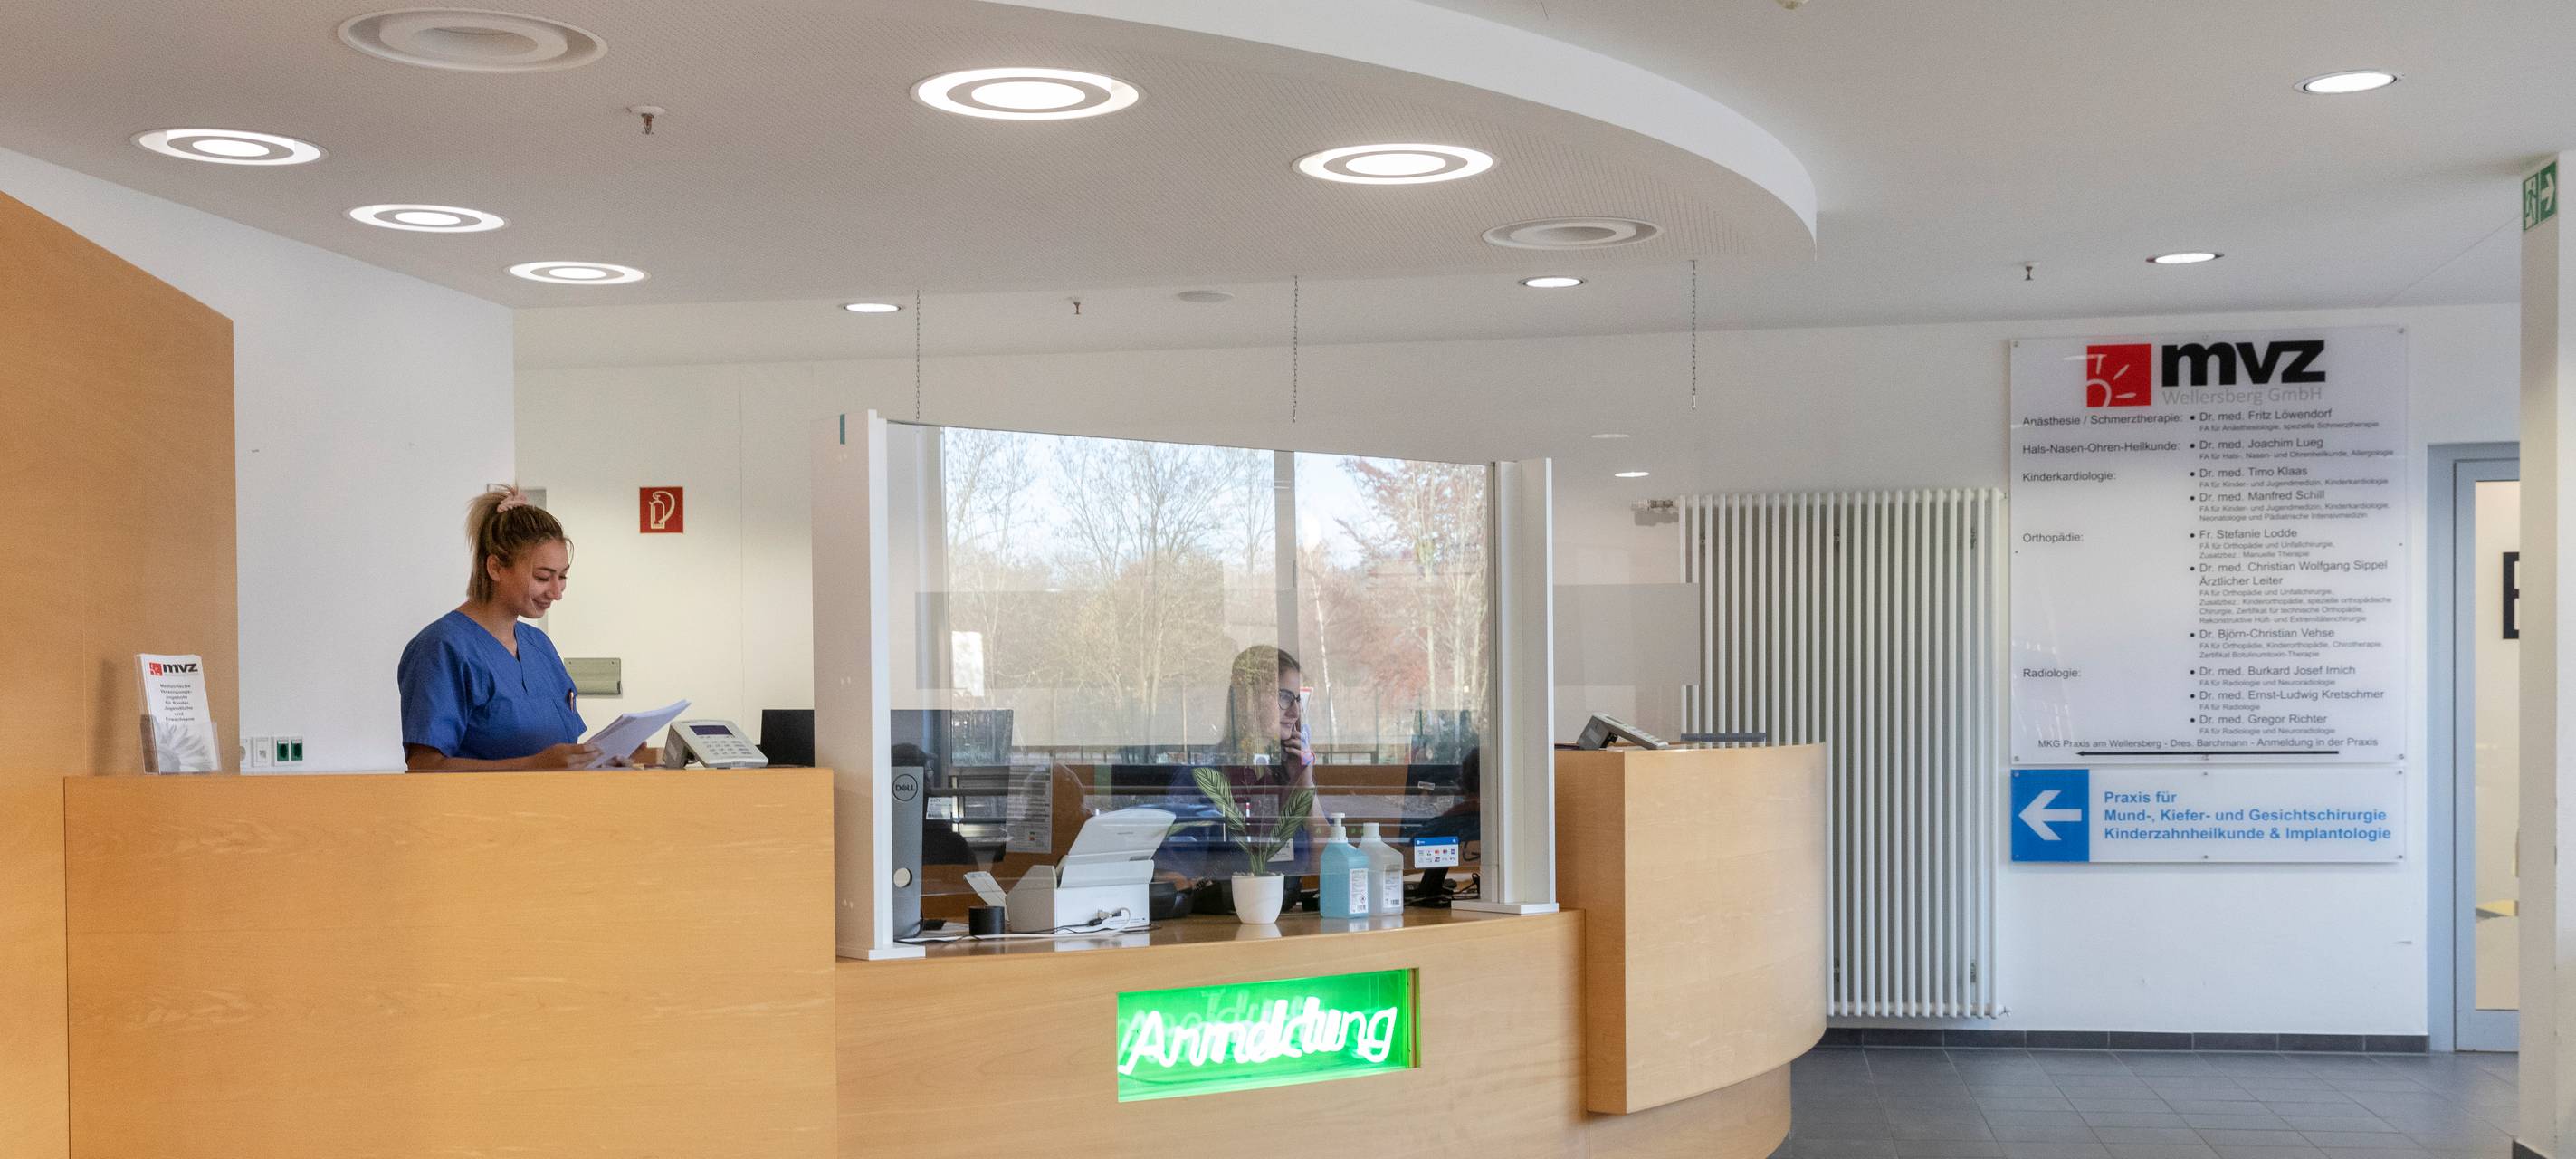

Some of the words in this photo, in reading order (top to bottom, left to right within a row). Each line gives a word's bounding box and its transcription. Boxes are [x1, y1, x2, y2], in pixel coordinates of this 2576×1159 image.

[2161, 340, 2325, 387] mvz
[2162, 388, 2263, 406] Wellersberg
[2268, 387, 2323, 402] GmbH
[2022, 416, 2081, 426] Anästhesie
[2090, 414, 2183, 426] Schmerztherapie:
[2199, 411, 2215, 422] Dr.
[2218, 411, 2244, 421] med.
[2247, 410, 2272, 420] Fritz
[2275, 408, 2333, 420] Löwendorf
[2022, 442, 2180, 455] Hals-Nasen-Ohren-Heilkunde:
[2199, 440, 2215, 450] Dr.
[2218, 440, 2244, 449] med.
[2247, 438, 2294, 449] Joachim
[2295, 438, 2323, 449] Lueg
[2022, 471, 2116, 483] Kinderkardiologie:
[2199, 468, 2215, 478] Dr.
[2218, 468, 2244, 478] med.
[2247, 467, 2275, 476] Timo
[2276, 466, 2308, 476] Klaas
[2199, 492, 2215, 503] Dr.
[2218, 493, 2244, 502] med.
[2247, 491, 2293, 501] Manfred
[2295, 490, 2325, 500] Schill
[2022, 532, 2084, 544] Orthopädie:
[2199, 530, 2214, 540] Fr.
[2217, 529, 2261, 540] Stefanie
[2264, 529, 2298, 539] Lodde
[2199, 563, 2215, 573] Dr.
[2218, 563, 2244, 572] med.
[2247, 561, 2296, 572] Christian
[2298, 561, 2351, 573] Wolfgang
[2352, 560, 2389, 572] Sippel
[2199, 575, 2250, 587] Ärztlicher
[2252, 576, 2283, 587] Leiter
[2199, 629, 2215, 639] Dr.
[2218, 628, 2297, 641] Björn-Christian
[2300, 628, 2335, 637] Vehse
[163, 663, 198, 674] mvz
[2022, 668, 2082, 679] Radiologie:
[2199, 666, 2215, 676] Dr.
[2218, 666, 2244, 675] med.
[2247, 666, 2290, 675] Burkard
[2294, 665, 2323, 675] Josef
[2199, 690, 2215, 701] Dr.
[2218, 690, 2244, 700] med.
[2247, 690, 2318, 702] Ernst-Ludwig
[2321, 689, 2385, 700] Kretschmer
[2199, 714, 2215, 724] Dr.
[2218, 714, 2244, 724] med.
[2247, 714, 2285, 726] Gregor
[2288, 714, 2328, 724] Richter
[2037, 740, 2061, 748] MKG
[2063, 739, 2091, 748] Praxis
[2109, 739, 2162, 750] Wellersberg
[2170, 739, 2193, 748] Dres.
[2197, 739, 2248, 748] Barchmann
[2256, 737, 2314, 748] Anmeldung
[2315, 737, 2325, 747] in
[2327, 737, 2343, 747] der
[2346, 737, 2379, 747] Praxis
[2104, 791, 2151, 804] Praxis
[2155, 790, 2177, 804] für
[2104, 809, 2156, 823] Mund-,
[2161, 809, 2210, 822] Kiefer-
[2216, 808, 2244, 821] und
[2249, 808, 2388, 824] Gesichtschirurgie
[2104, 826, 2264, 840] Kinderzahnheilkunde
[2268, 827, 2281, 840] &
[2285, 826, 2391, 842] Implantologie
[1117, 996, 1398, 1075] Anmeldung
